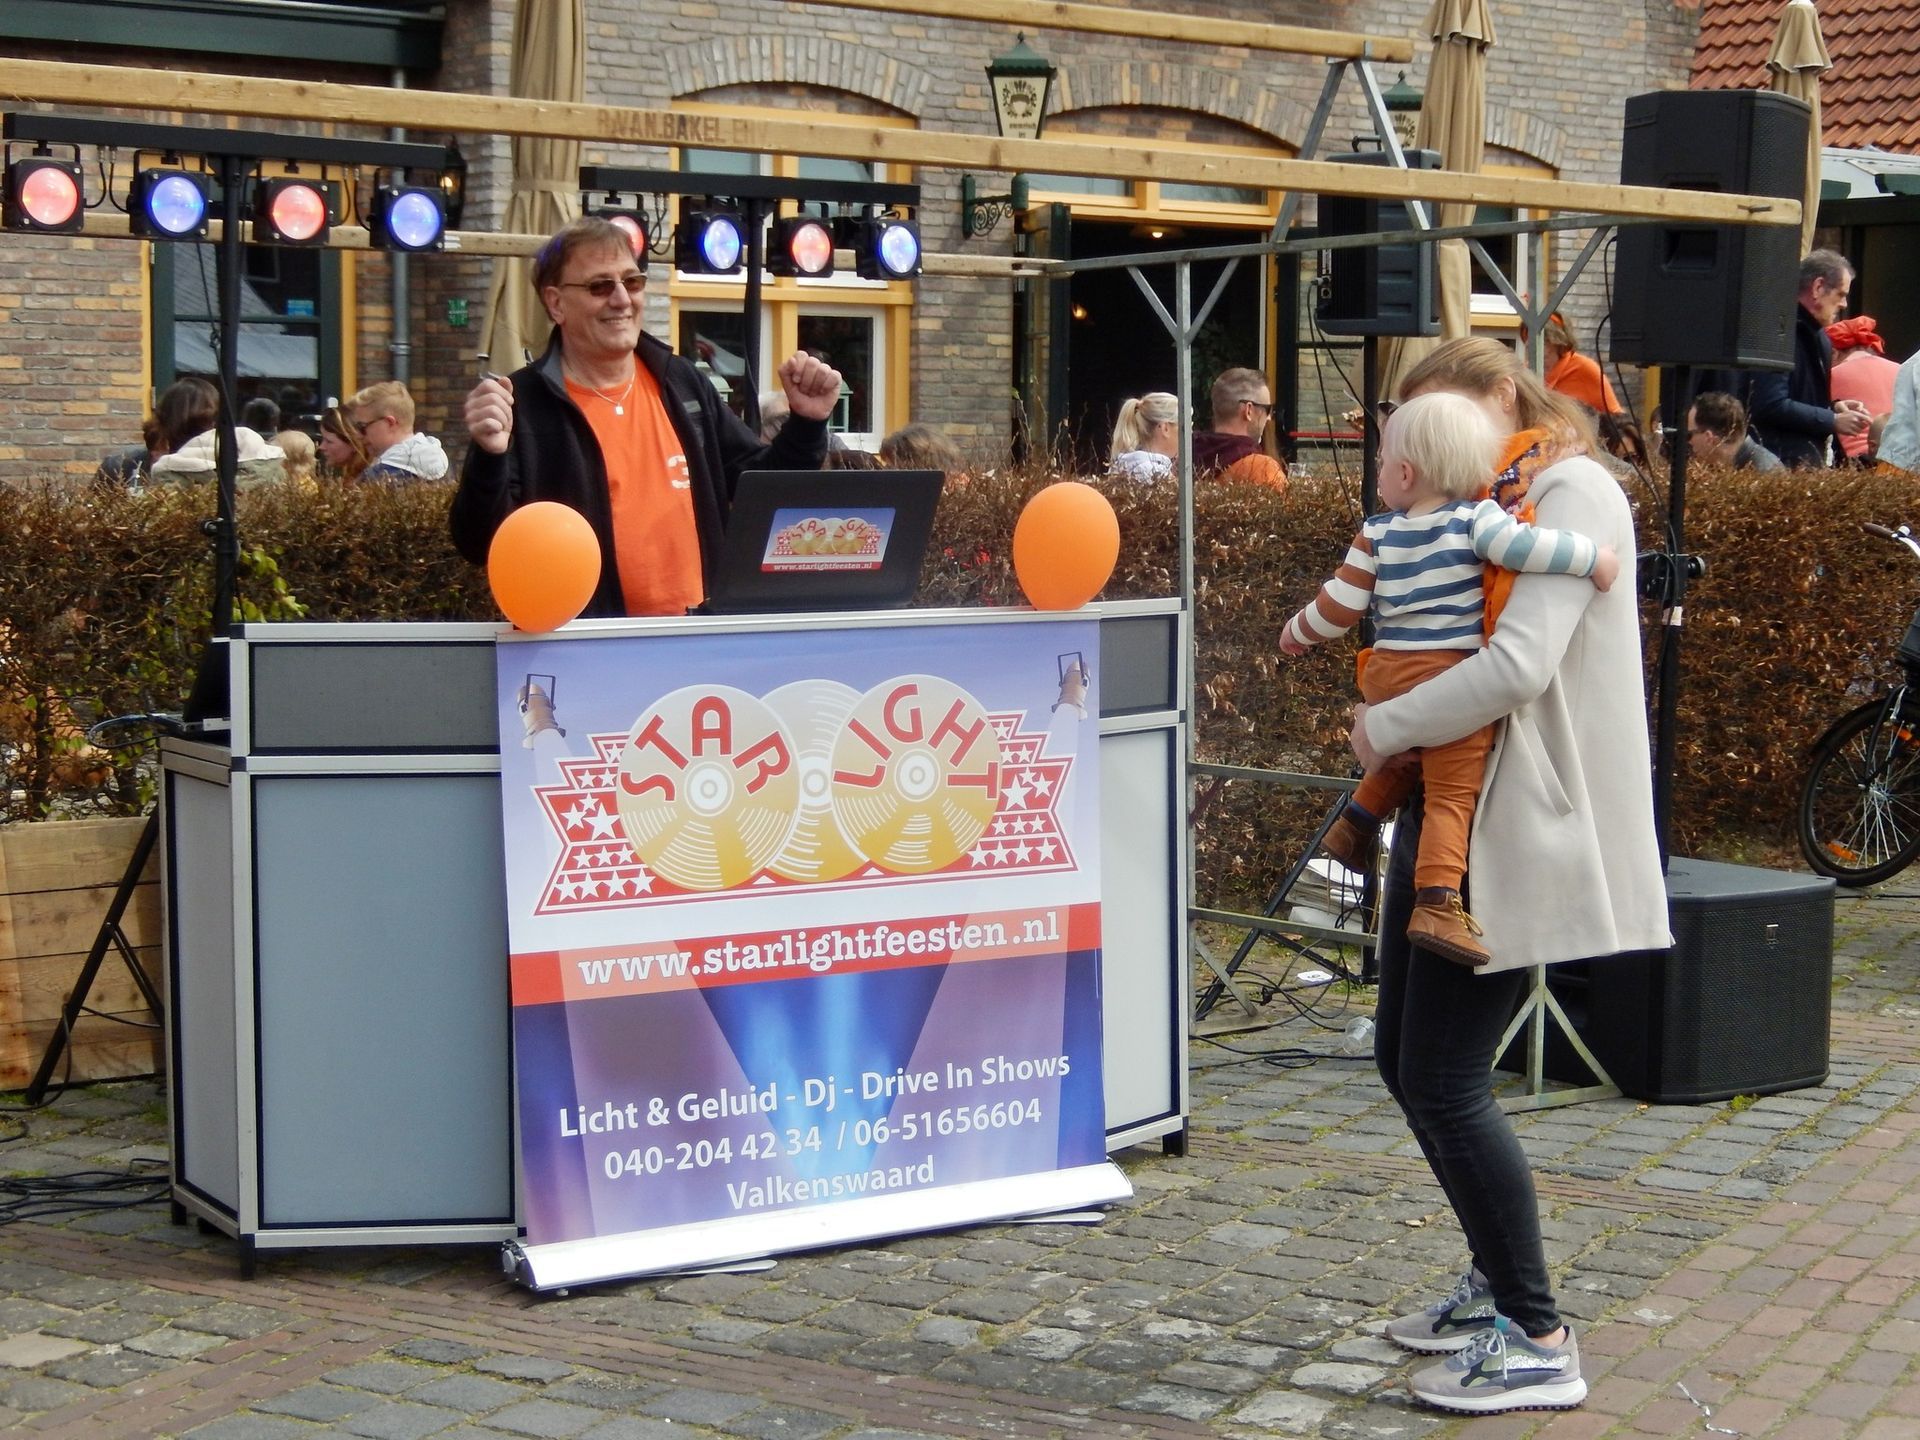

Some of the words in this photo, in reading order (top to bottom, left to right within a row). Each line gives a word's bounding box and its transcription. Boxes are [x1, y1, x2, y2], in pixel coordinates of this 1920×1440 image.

[792, 520, 826, 538] STAR
[834, 519, 868, 540] LIGHT
[620, 695, 791, 802] STAR
[833, 683, 999, 802] LIGHT
[559, 1102, 639, 1138] Licht
[647, 1098, 671, 1127] &
[677, 1083, 778, 1121] Geluid
[804, 1076, 837, 1112] Dj
[862, 1068, 938, 1100] Drive
[946, 1062, 973, 1088] In
[981, 1053, 1071, 1083] Shows
[604, 1138, 733, 1180] 040-204
[740, 1131, 777, 1161] 42
[785, 1126, 822, 1156] 34
[854, 1097, 1042, 1147] 06-51656604
[727, 1155, 935, 1210] Valkenswaard
